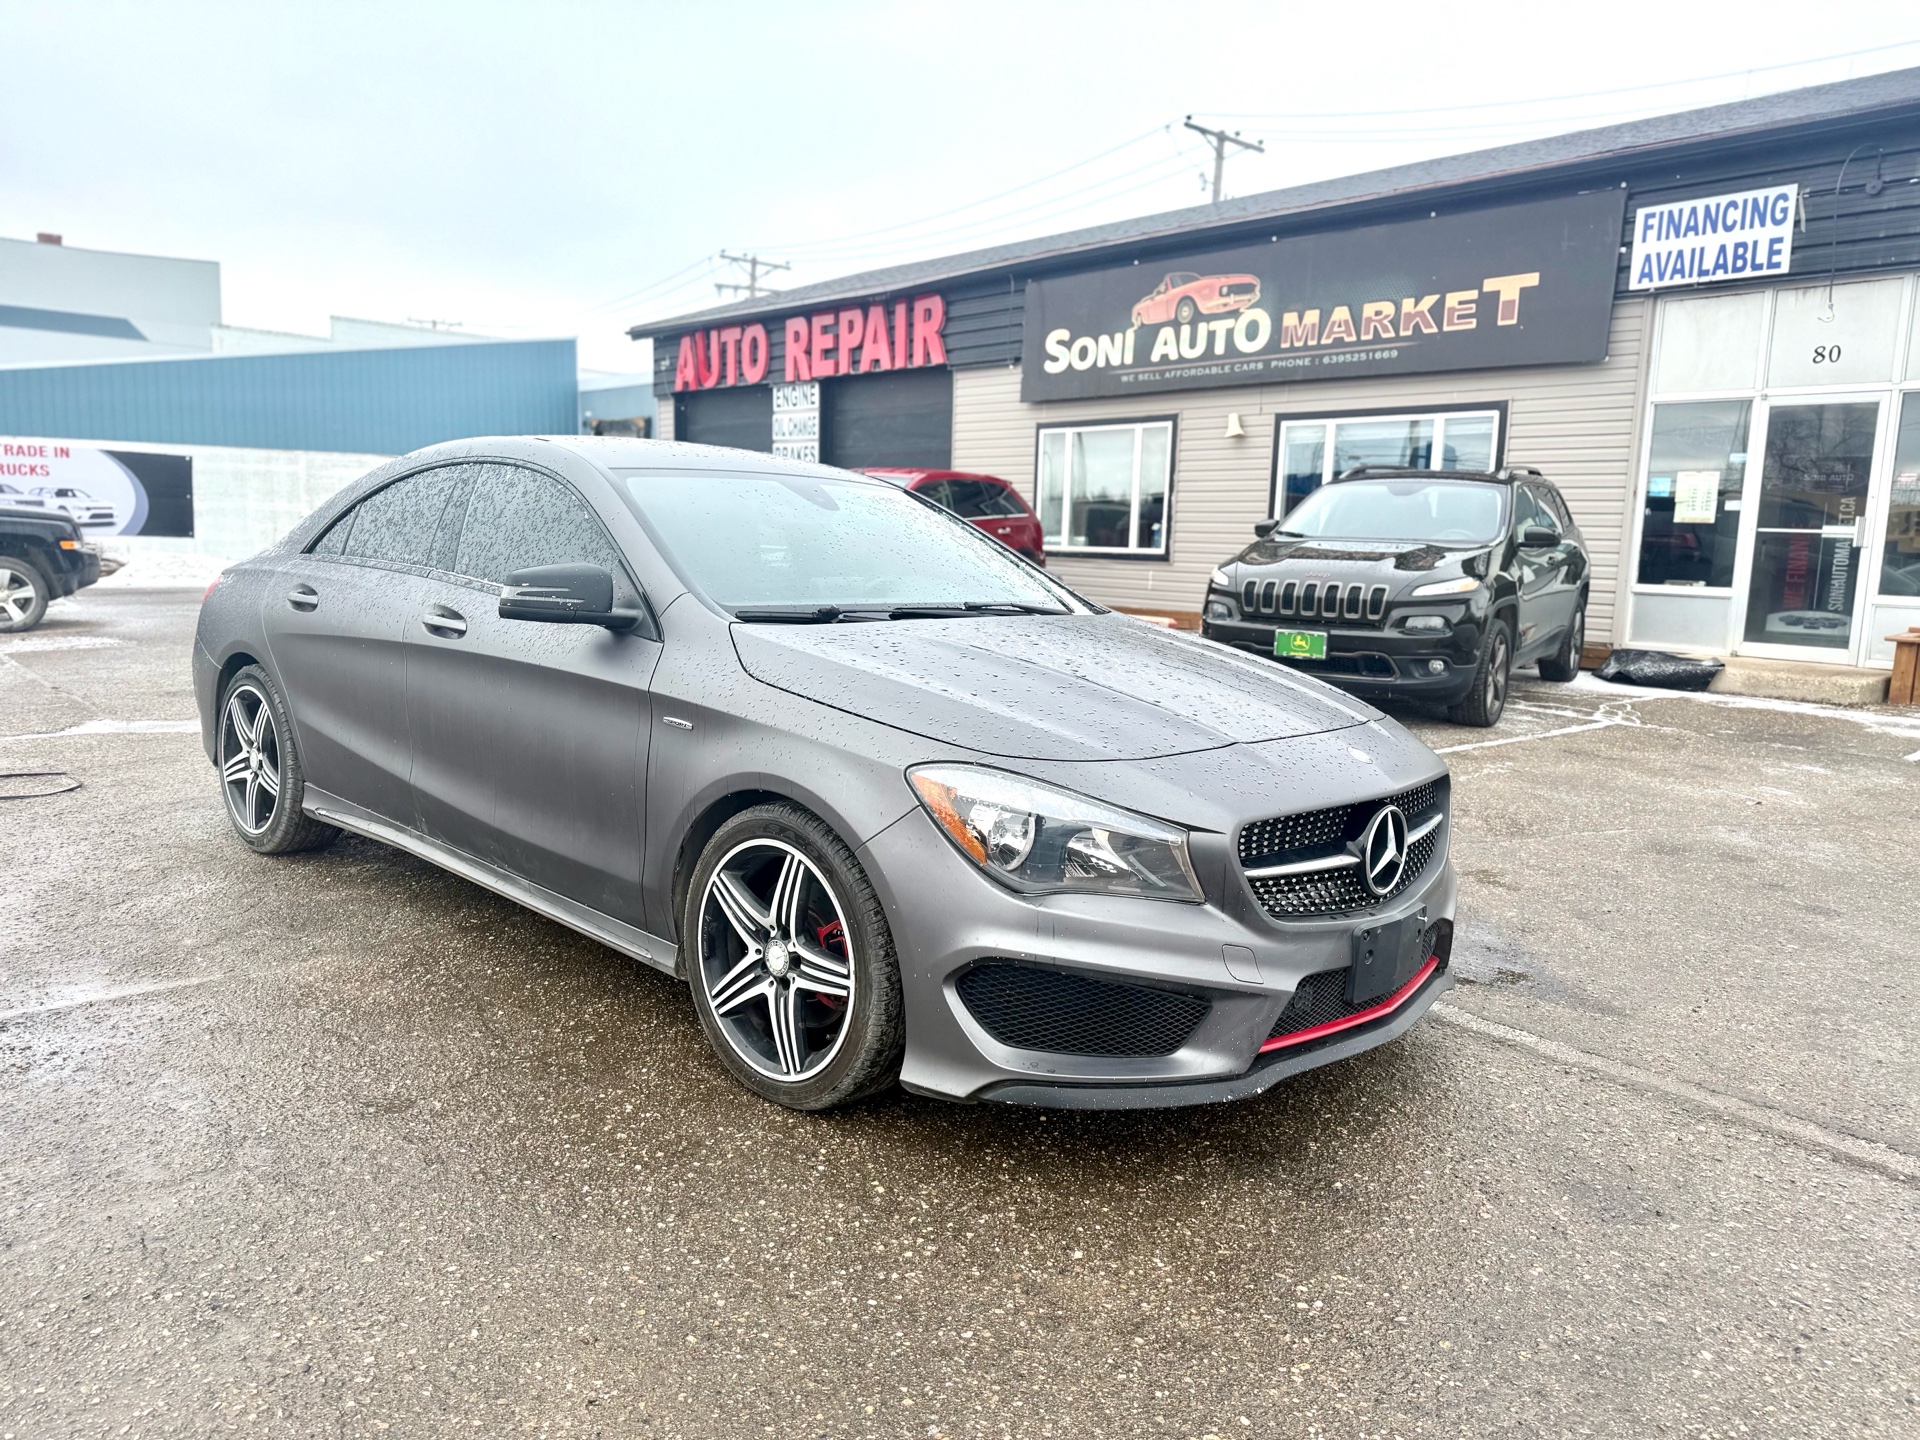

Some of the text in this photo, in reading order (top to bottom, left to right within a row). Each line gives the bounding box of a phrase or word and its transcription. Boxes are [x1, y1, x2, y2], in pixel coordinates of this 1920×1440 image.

[1641, 192, 1790, 244] FINANCING
[1637, 236, 1785, 284] AVAILABLE
[1043, 272, 1540, 374] SONI AUTO MARKET
[674, 293, 947, 392] AUTO REPAIR
[1812, 344, 1841, 364] 80
[1120, 374, 1135, 383] WE
[1138, 371, 1161, 381] SELL
[1164, 363, 1231, 379] AFFORDABLE
[1234, 358, 1264, 372] CARS
[1270, 357, 1312, 369] PHONE
[1322, 349, 1399, 365] 6395251669
[776, 384, 816, 409] ENGINE
[0, 443, 70, 459] RADE IN
[1305, 571, 1331, 579] Jeep
